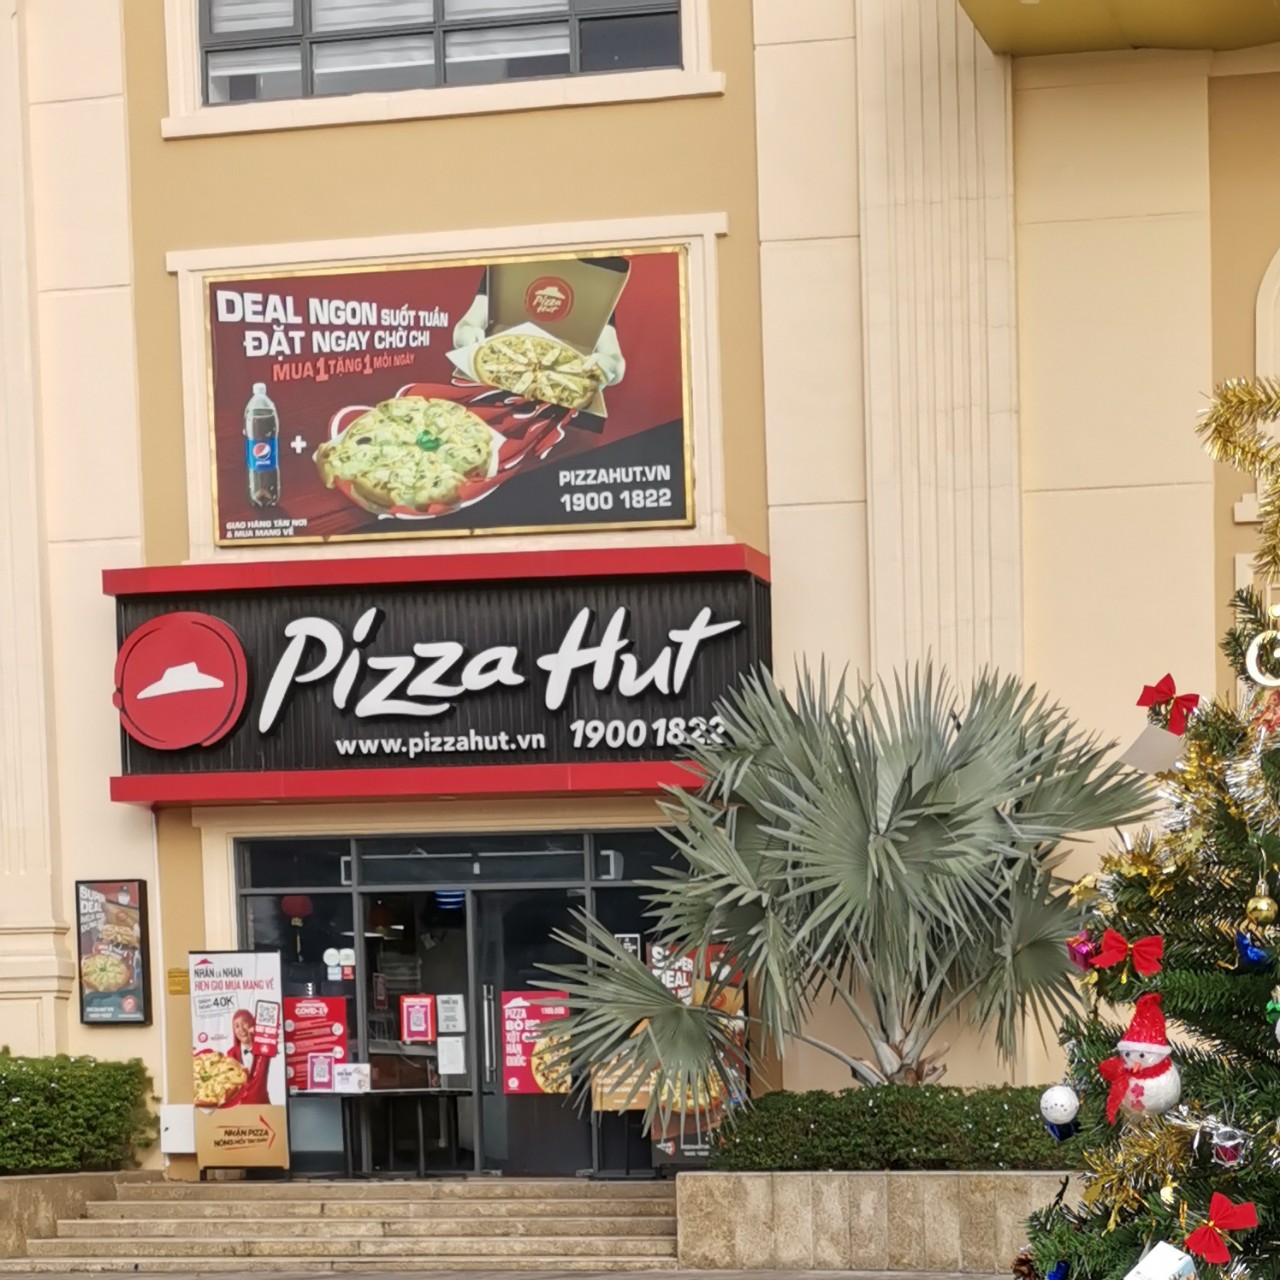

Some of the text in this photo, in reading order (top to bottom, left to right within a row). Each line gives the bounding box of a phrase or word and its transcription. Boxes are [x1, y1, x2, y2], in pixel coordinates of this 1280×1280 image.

[216, 289, 303, 324] DEAL
[308, 298, 378, 326] NGON
[532, 295, 562, 307] Pizza
[537, 304, 560, 314] Hut
[243, 324, 431, 361] ĐẶT NGAY CHỜ CHI
[272, 362, 314, 382] MUA
[315, 356, 329, 382] 1
[328, 355, 363, 378] TẶNG
[363, 353, 374, 375] 1
[558, 464, 671, 487] PIZZAHUT.VN
[560, 488, 672, 513] 1900 1822
[258, 606, 742, 734] Pizza Hut
[335, 728, 547, 759] www.pizzahut.vn
[569, 718, 647, 749] 1900
[652, 945, 694, 971] SPER
[213, 995, 235, 1007] 40K
